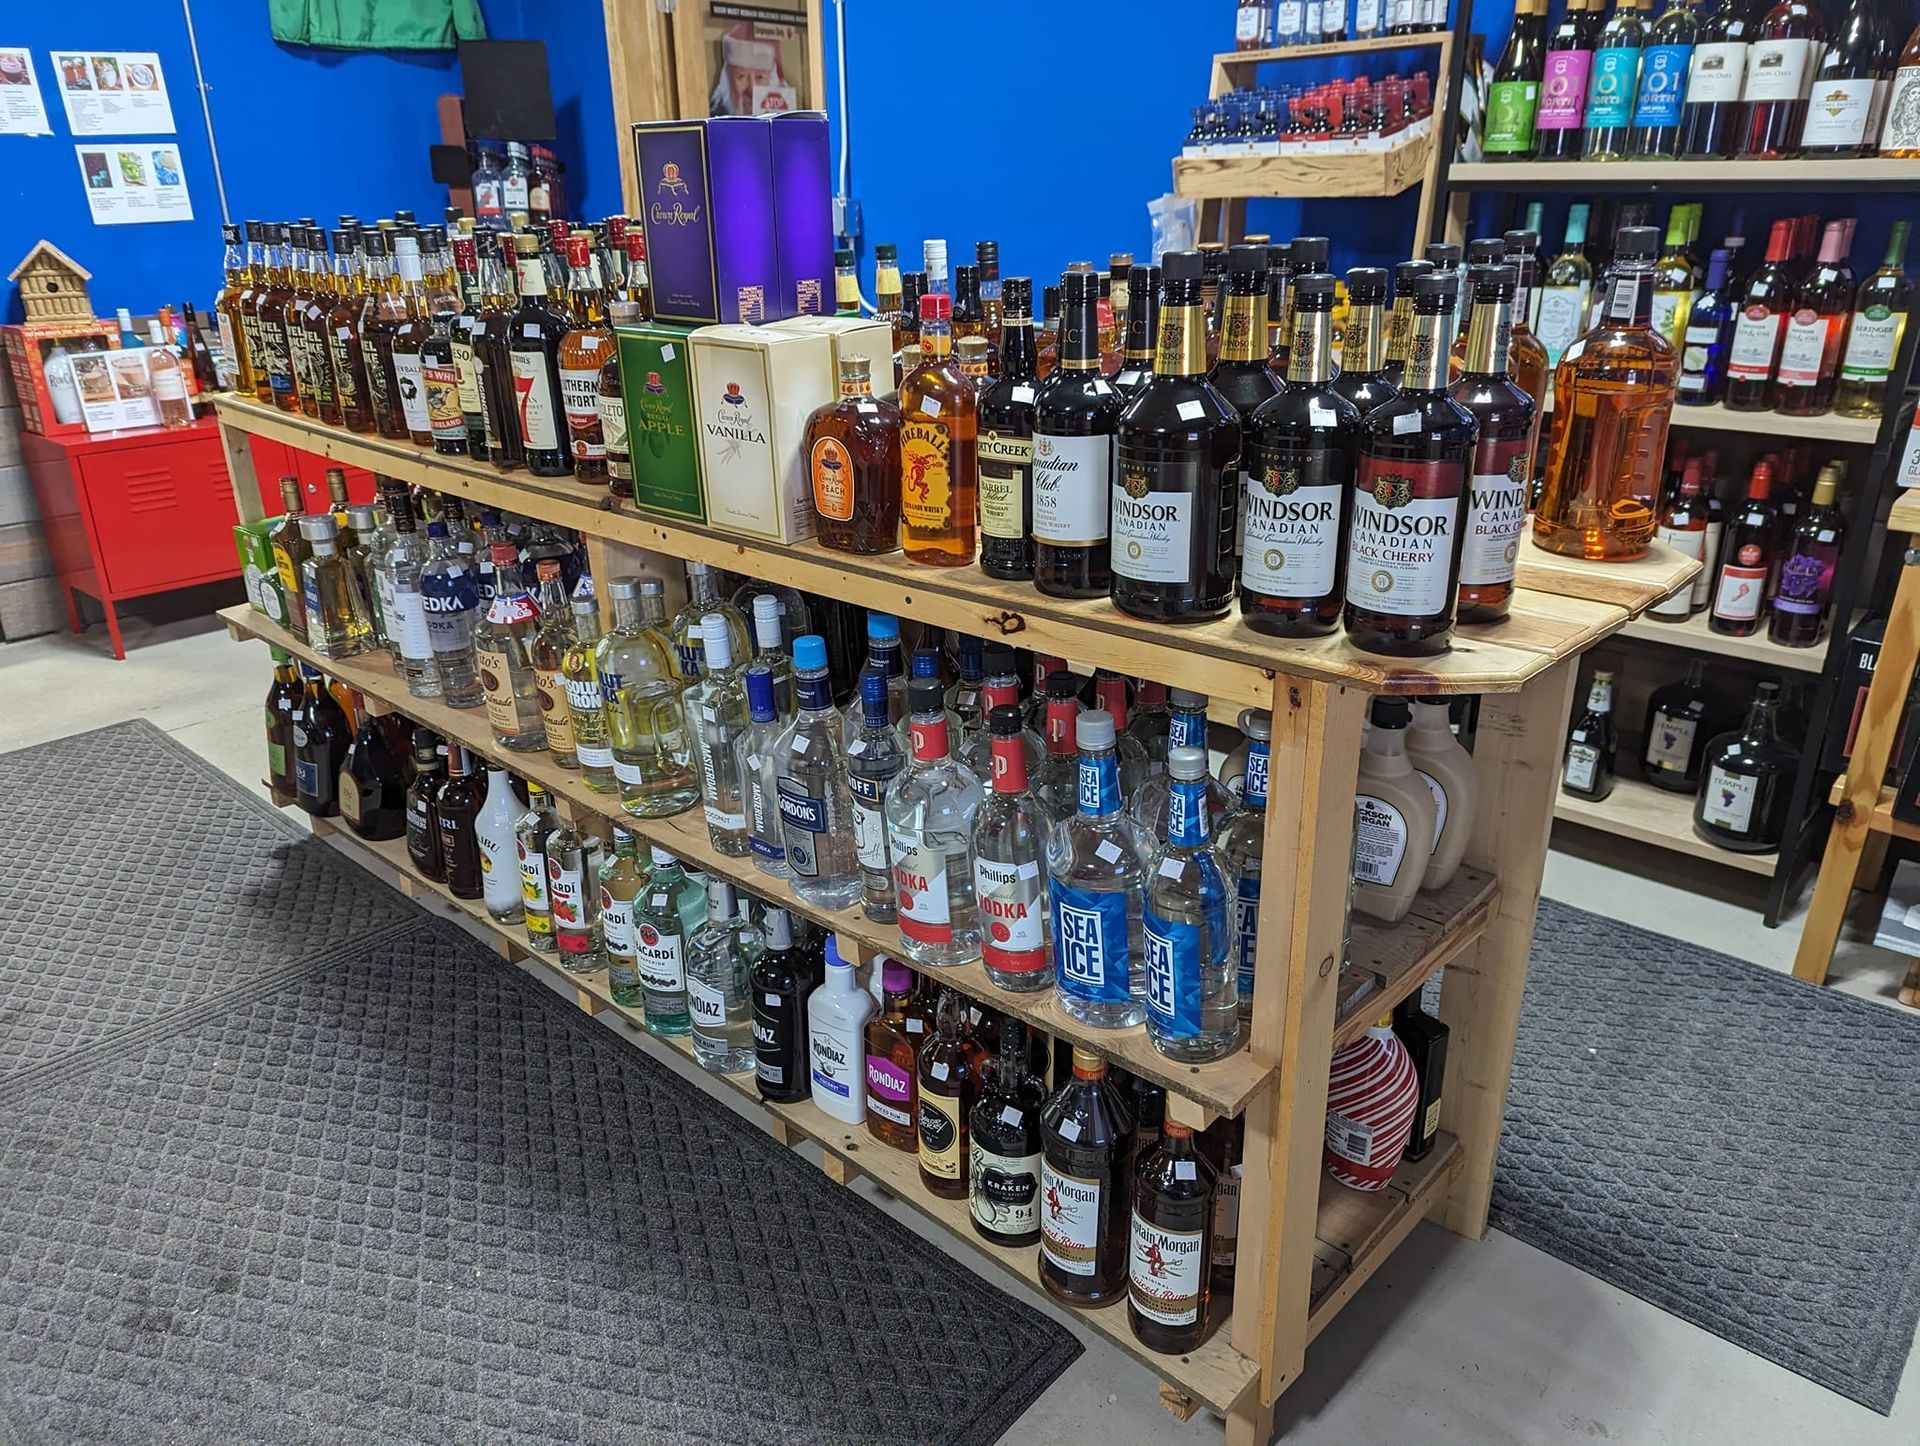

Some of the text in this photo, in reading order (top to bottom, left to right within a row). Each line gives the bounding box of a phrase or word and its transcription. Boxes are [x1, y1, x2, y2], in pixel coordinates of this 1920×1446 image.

[651, 201, 701, 227] Crown Royal
[513, 376, 535, 443] 7
[717, 408, 753, 428] Crown Royal
[638, 420, 686, 437] APPLE
[706, 423, 767, 445] VANILLA
[900, 426, 947, 455] FIREBALL
[992, 441, 1029, 458] CREEK
[821, 483, 846, 496] PEACH
[924, 504, 944, 514] WHISKY
[1036, 493, 1058, 508] 1858
[1247, 515, 1320, 535] CANADIAN
[1475, 523, 1512, 536] BLACK
[1296, 534, 1324, 547] Whisky
[1354, 527, 1433, 550] CANADIAN
[1382, 549, 1435, 563] CHERRY
[1655, 722, 1690, 736] TEMPLE
[700, 742, 719, 801] AMSTERDAM
[1250, 756, 1268, 775] SEA
[1080, 768, 1098, 786] SEA
[1247, 771, 1268, 793] ICE
[1713, 777, 1751, 793] TEMPLE
[1080, 783, 1098, 804] ICE
[751, 781, 765, 834] AMSTERDAM
[778, 793, 817, 822] GORDON'S
[890, 833, 918, 857] Phillips
[979, 864, 1017, 885] Phillips
[978, 891, 1028, 919] VODKA
[1063, 911, 1100, 946] SEA
[1065, 938, 1101, 978] ICE
[819, 1077, 840, 1091] COCONUT
[873, 1102, 902, 1120] SPICED RUM
[987, 1180, 1030, 1193] KRAKEN
[1055, 1179, 1096, 1204] Morgan
[1015, 1207, 1033, 1220] 94
[1059, 1236, 1087, 1251] Rum
[1158, 1233, 1200, 1256] Morgan
[1159, 1290, 1188, 1301] Rum
